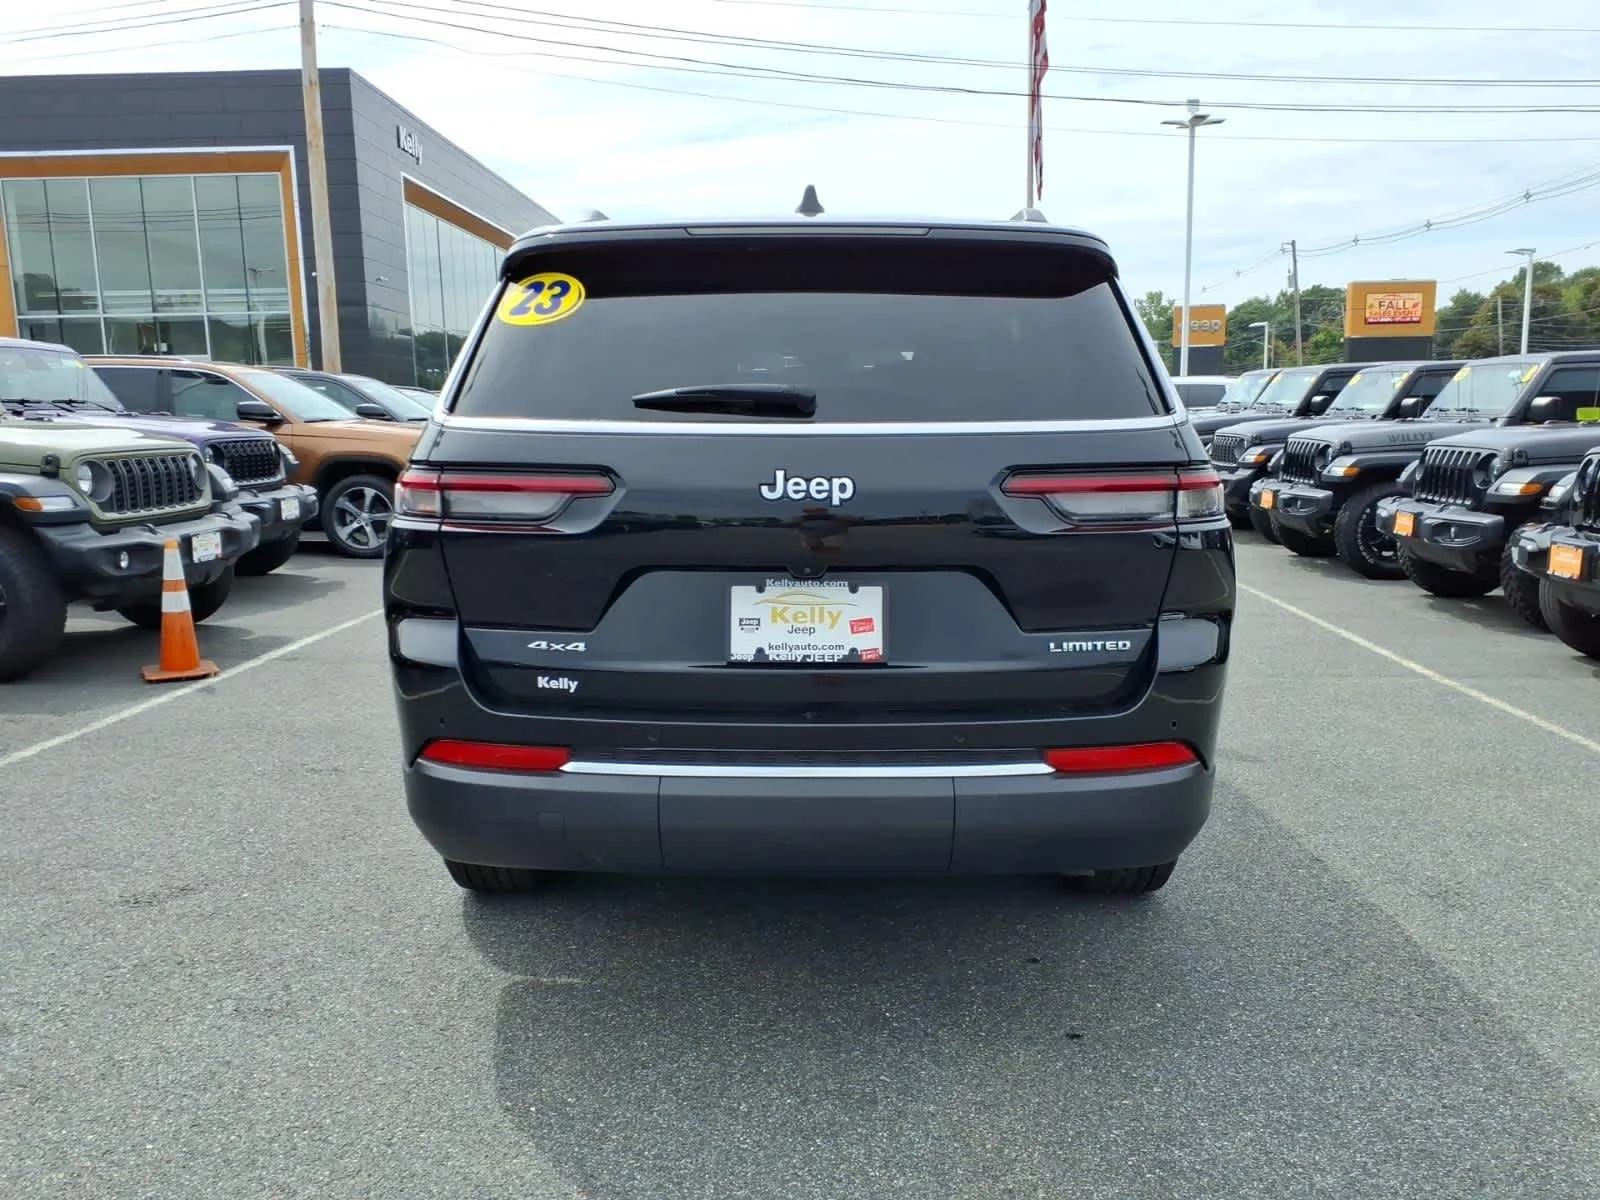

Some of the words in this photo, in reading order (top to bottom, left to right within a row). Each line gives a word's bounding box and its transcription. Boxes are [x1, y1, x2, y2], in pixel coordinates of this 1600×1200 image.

[397, 125, 423, 165] Kelly
[509, 280, 571, 315] 23
[1378, 300, 1409, 310] FALL
[760, 469, 854, 506] Jeep
[765, 578, 849, 589] Kellyauto.com
[770, 606, 844, 629] Kelly
[786, 625, 816, 637] Jeep
[527, 640, 588, 652] 4x4
[768, 642, 845, 653] kellyauto.com
[1049, 640, 1131, 653] LIMITED
[768, 652, 804, 663] Kelly
[805, 653, 844, 662] JEEP
[536, 675, 579, 693] Kelly
